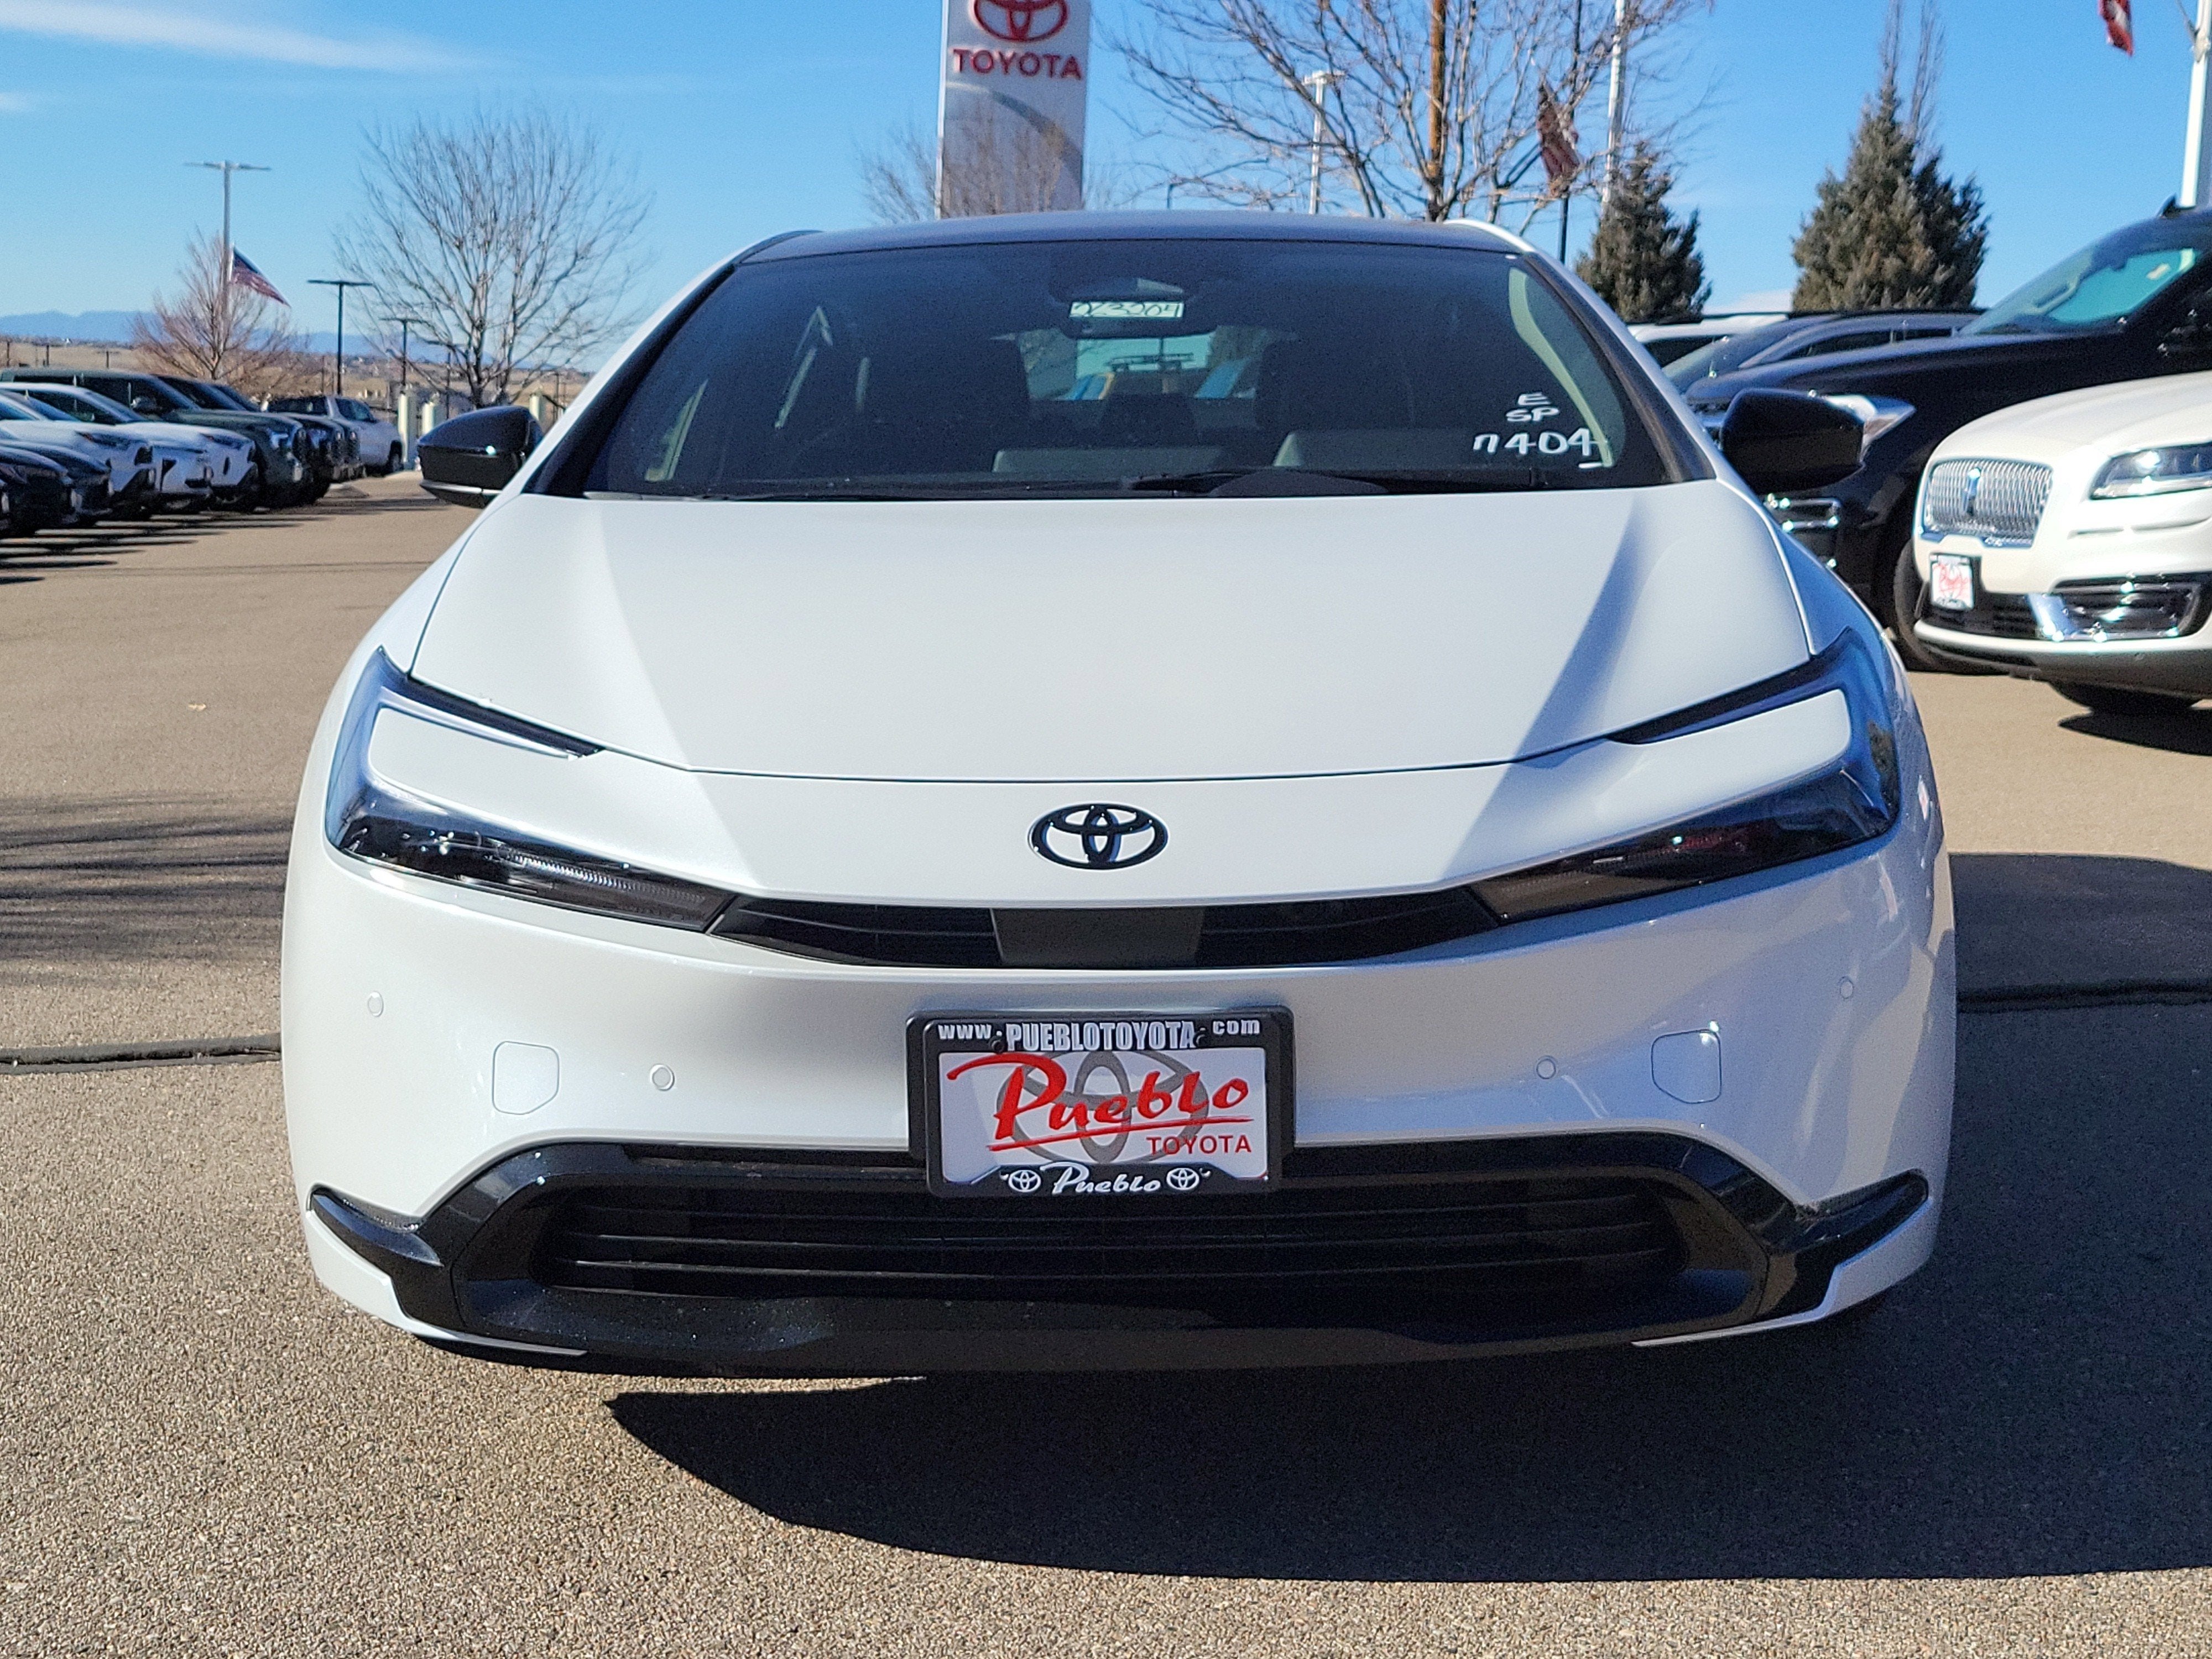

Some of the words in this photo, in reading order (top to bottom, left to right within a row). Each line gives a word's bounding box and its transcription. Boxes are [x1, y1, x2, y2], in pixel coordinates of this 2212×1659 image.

[953, 49, 1082, 81] TOYOTA
[1517, 392, 1552, 406] E
[1505, 406, 1559, 422] SP
[946, 1052, 1249, 1140] Pueblo
[1146, 1135, 1252, 1155] TOYOTA
[1039, 1161, 1161, 1195] Pueblo
